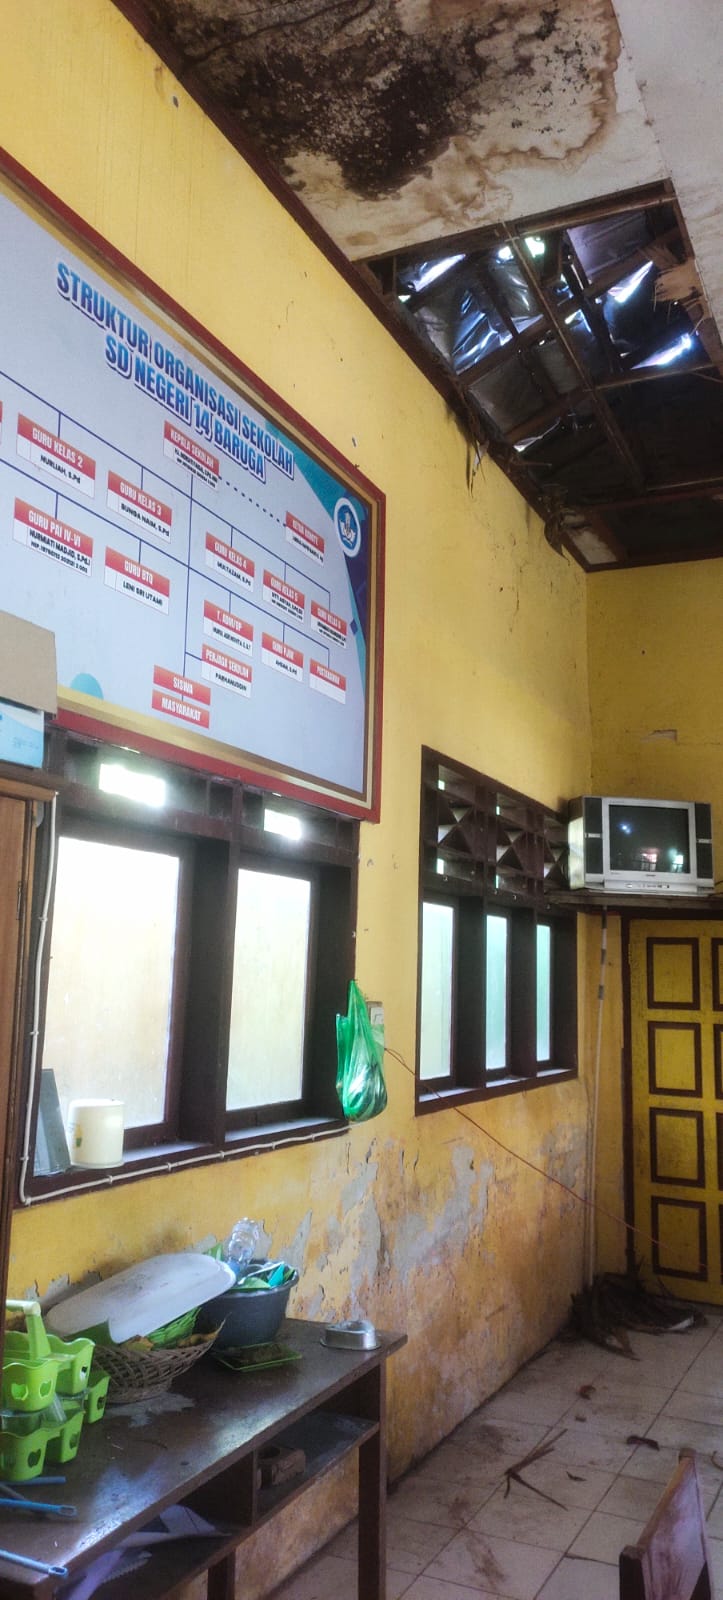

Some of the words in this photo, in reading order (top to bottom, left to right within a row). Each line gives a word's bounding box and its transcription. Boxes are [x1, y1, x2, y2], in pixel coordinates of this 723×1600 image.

[56, 261, 150, 358] STRUKTUR
[153, 341, 239, 430] ORGANISASI
[241, 414, 294, 477] SEKOLAH
[105, 334, 130, 374] SD
[134, 354, 190, 421] NEGERI
[193, 402, 211, 438] 14
[214, 423, 265, 480] BARUGA
[32, 427, 52, 449] GURU
[54, 438, 77, 464] KELAS
[78, 456, 84, 469] 2
[170, 428, 192, 451] KEPALA
[191, 444, 214, 469] SEKOLAH
[120, 482, 137, 501] GURU
[137, 489, 157, 512] KELAS
[28, 510, 49, 530] GURU
[50, 519, 62, 534] PAI
[63, 528, 81, 548] IV-VI
[214, 541, 228, 558] GURU
[228, 550, 242, 567] KELAS
[124, 560, 141, 577] GURU
[142, 569, 153, 585] BTQ
[282, 584, 294, 600] KELAS
[228, 660, 249, 679] SEKOLAH
[173, 677, 193, 694] SISWA
[161, 697, 202, 721] MASYARAKAT
